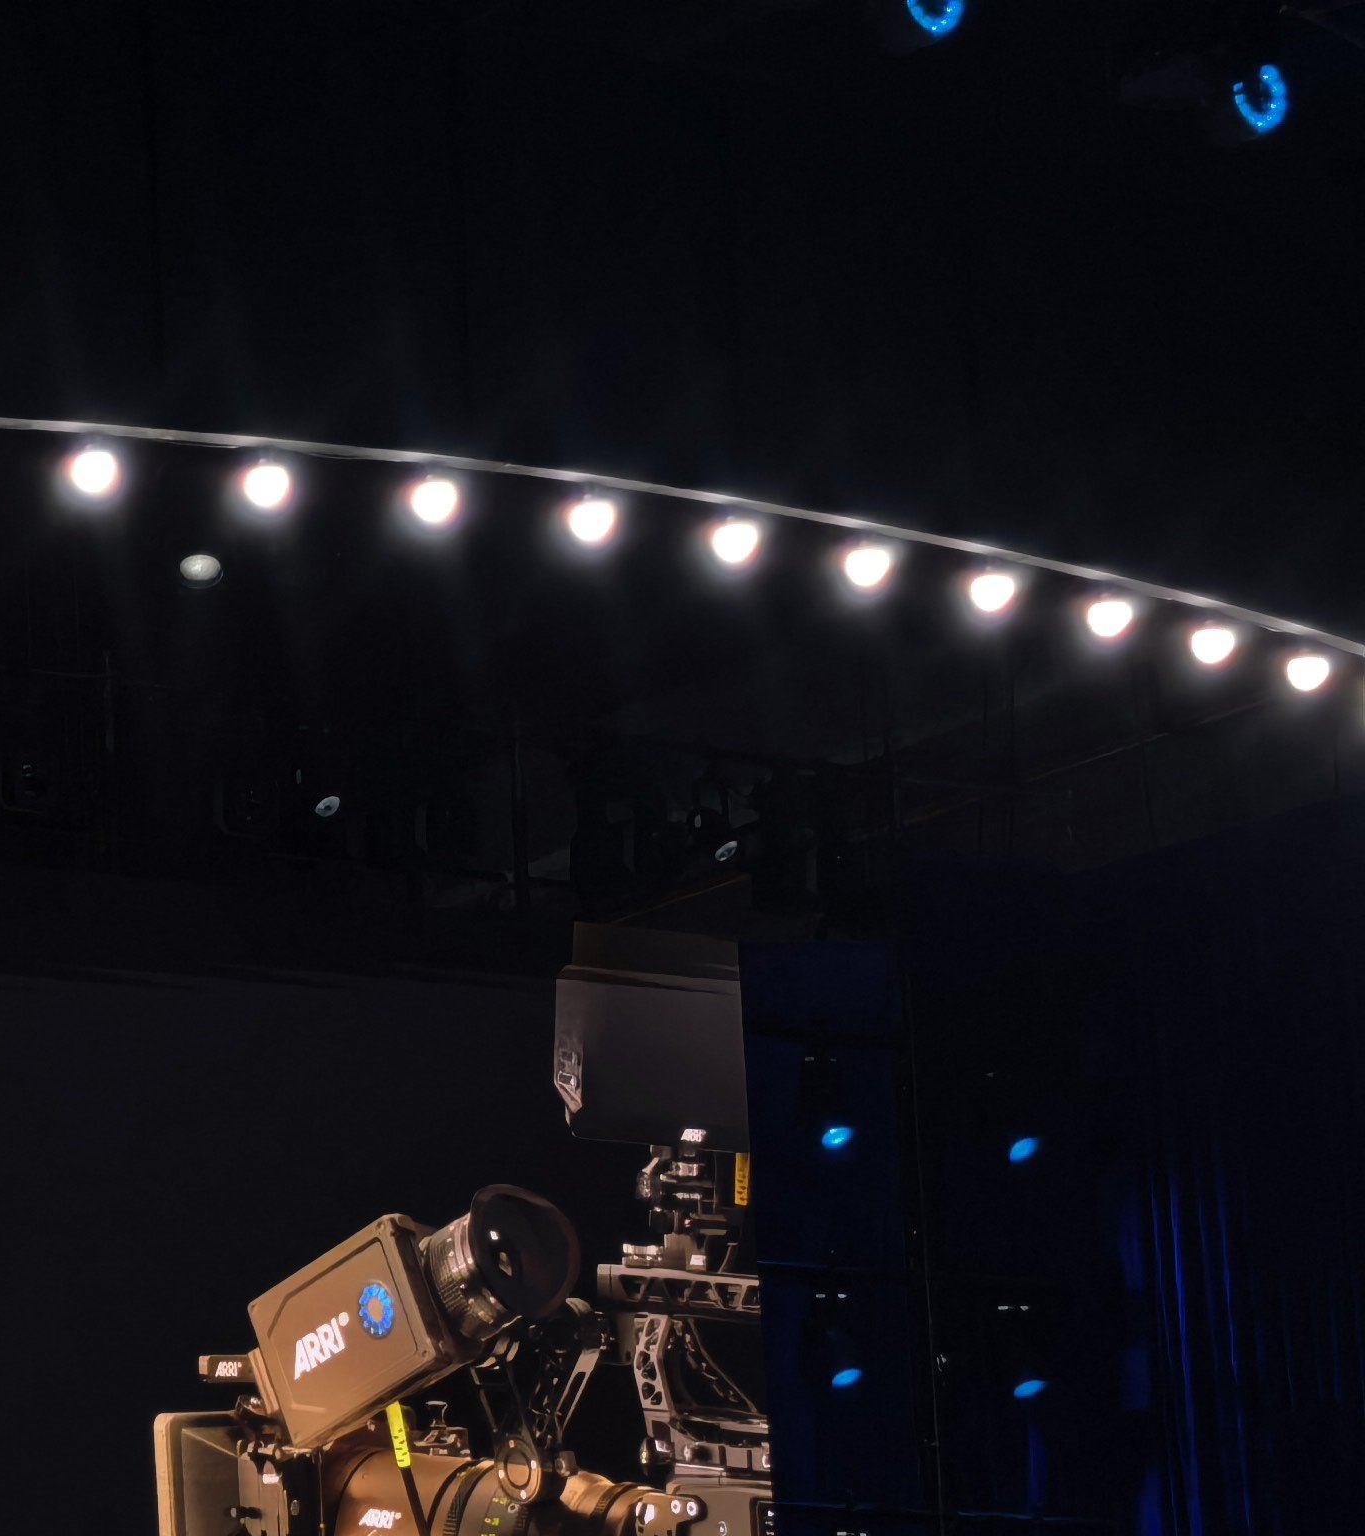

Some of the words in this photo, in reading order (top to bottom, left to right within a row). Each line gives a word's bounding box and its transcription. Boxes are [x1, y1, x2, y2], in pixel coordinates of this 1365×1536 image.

[294, 1316, 347, 1380] ARRI
[214, 1361, 238, 1377] ARRI
[358, 1508, 395, 1529] ARRI
